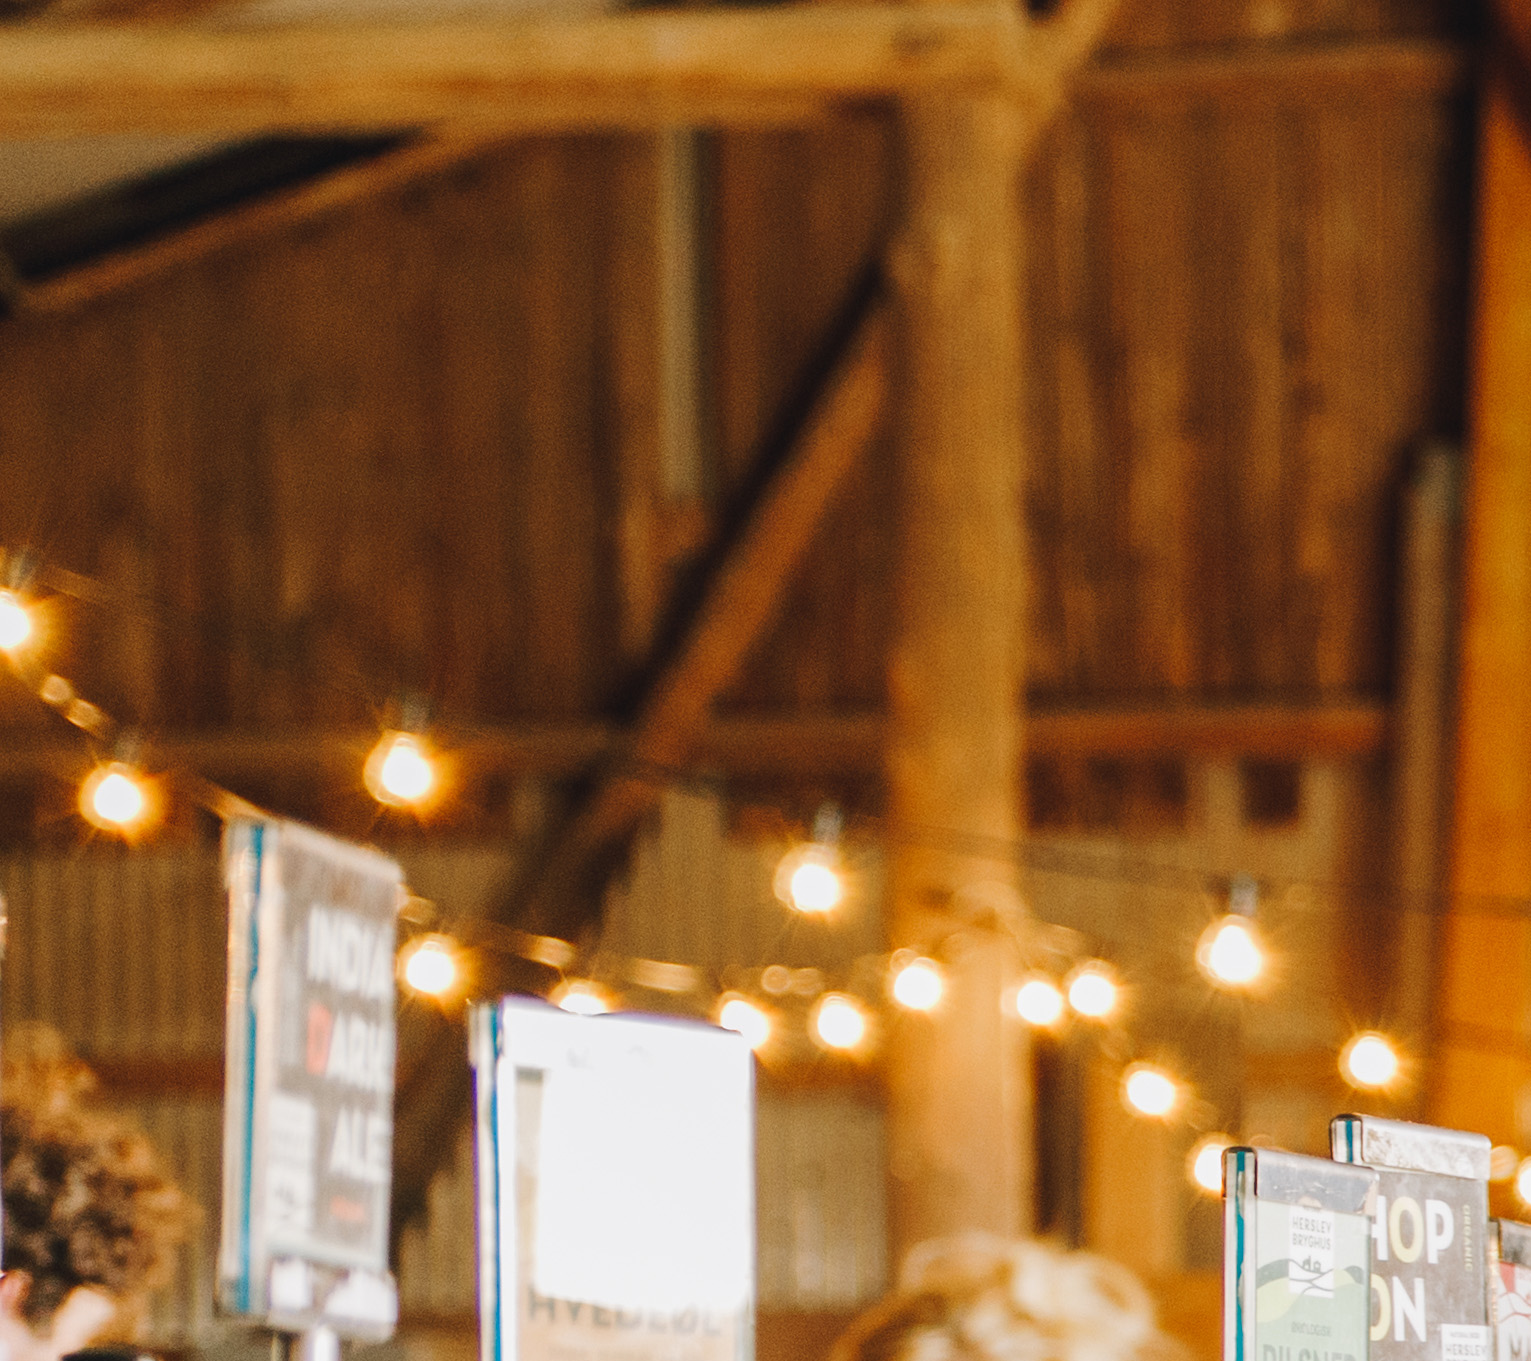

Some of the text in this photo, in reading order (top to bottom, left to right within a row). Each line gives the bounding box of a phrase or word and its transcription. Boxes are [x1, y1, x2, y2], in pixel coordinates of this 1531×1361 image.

[308, 904, 394, 999] INDIA
[329, 1104, 390, 1184] ALE
[1371, 1194, 1455, 1264] HOP
[1370, 1273, 1428, 1342] ON
